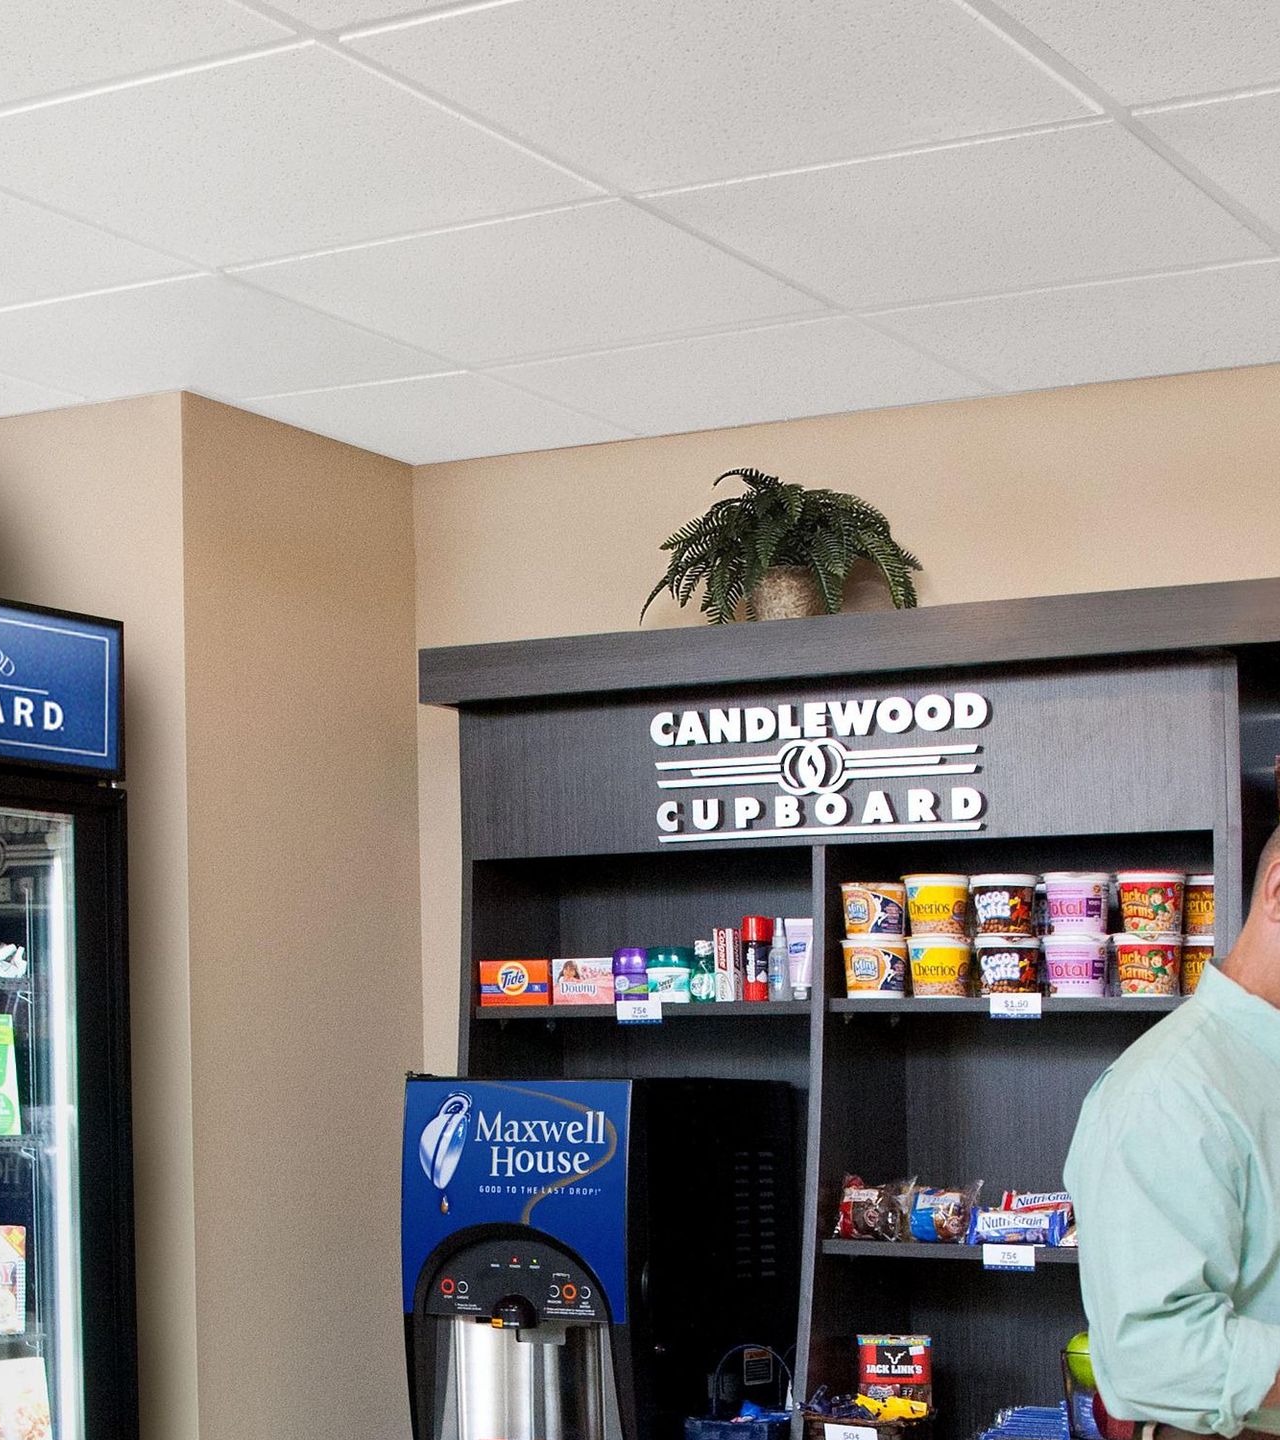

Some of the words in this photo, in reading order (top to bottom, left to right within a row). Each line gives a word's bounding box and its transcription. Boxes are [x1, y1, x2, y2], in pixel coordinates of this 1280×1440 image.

[650, 692, 988, 747] CANDLEWOOD
[656, 786, 983, 832] CUPBOARD
[974, 890, 1010, 908] Cocoa
[910, 900, 951, 916] Cheerios
[719, 929, 728, 972] Colgate
[980, 951, 1020, 970] Cocoa
[1050, 959, 1091, 978] Total
[914, 962, 957, 978] Cheerios
[500, 971, 525, 988] Tide
[560, 982, 597, 996] Downy
[474, 1110, 606, 1145] Maxwell
[489, 1145, 591, 1178] House
[479, 1185, 503, 1194] GOOD
[506, 1185, 518, 1194] TO
[520, 1185, 539, 1195] THE
[541, 1186, 566, 1195] LAST
[1001, 1251, 1017, 1260] 75¢
[866, 1364, 890, 1375] JACK
[891, 1363, 923, 1375] LINK'S
[843, 1431, 860, 1440] 50¢
